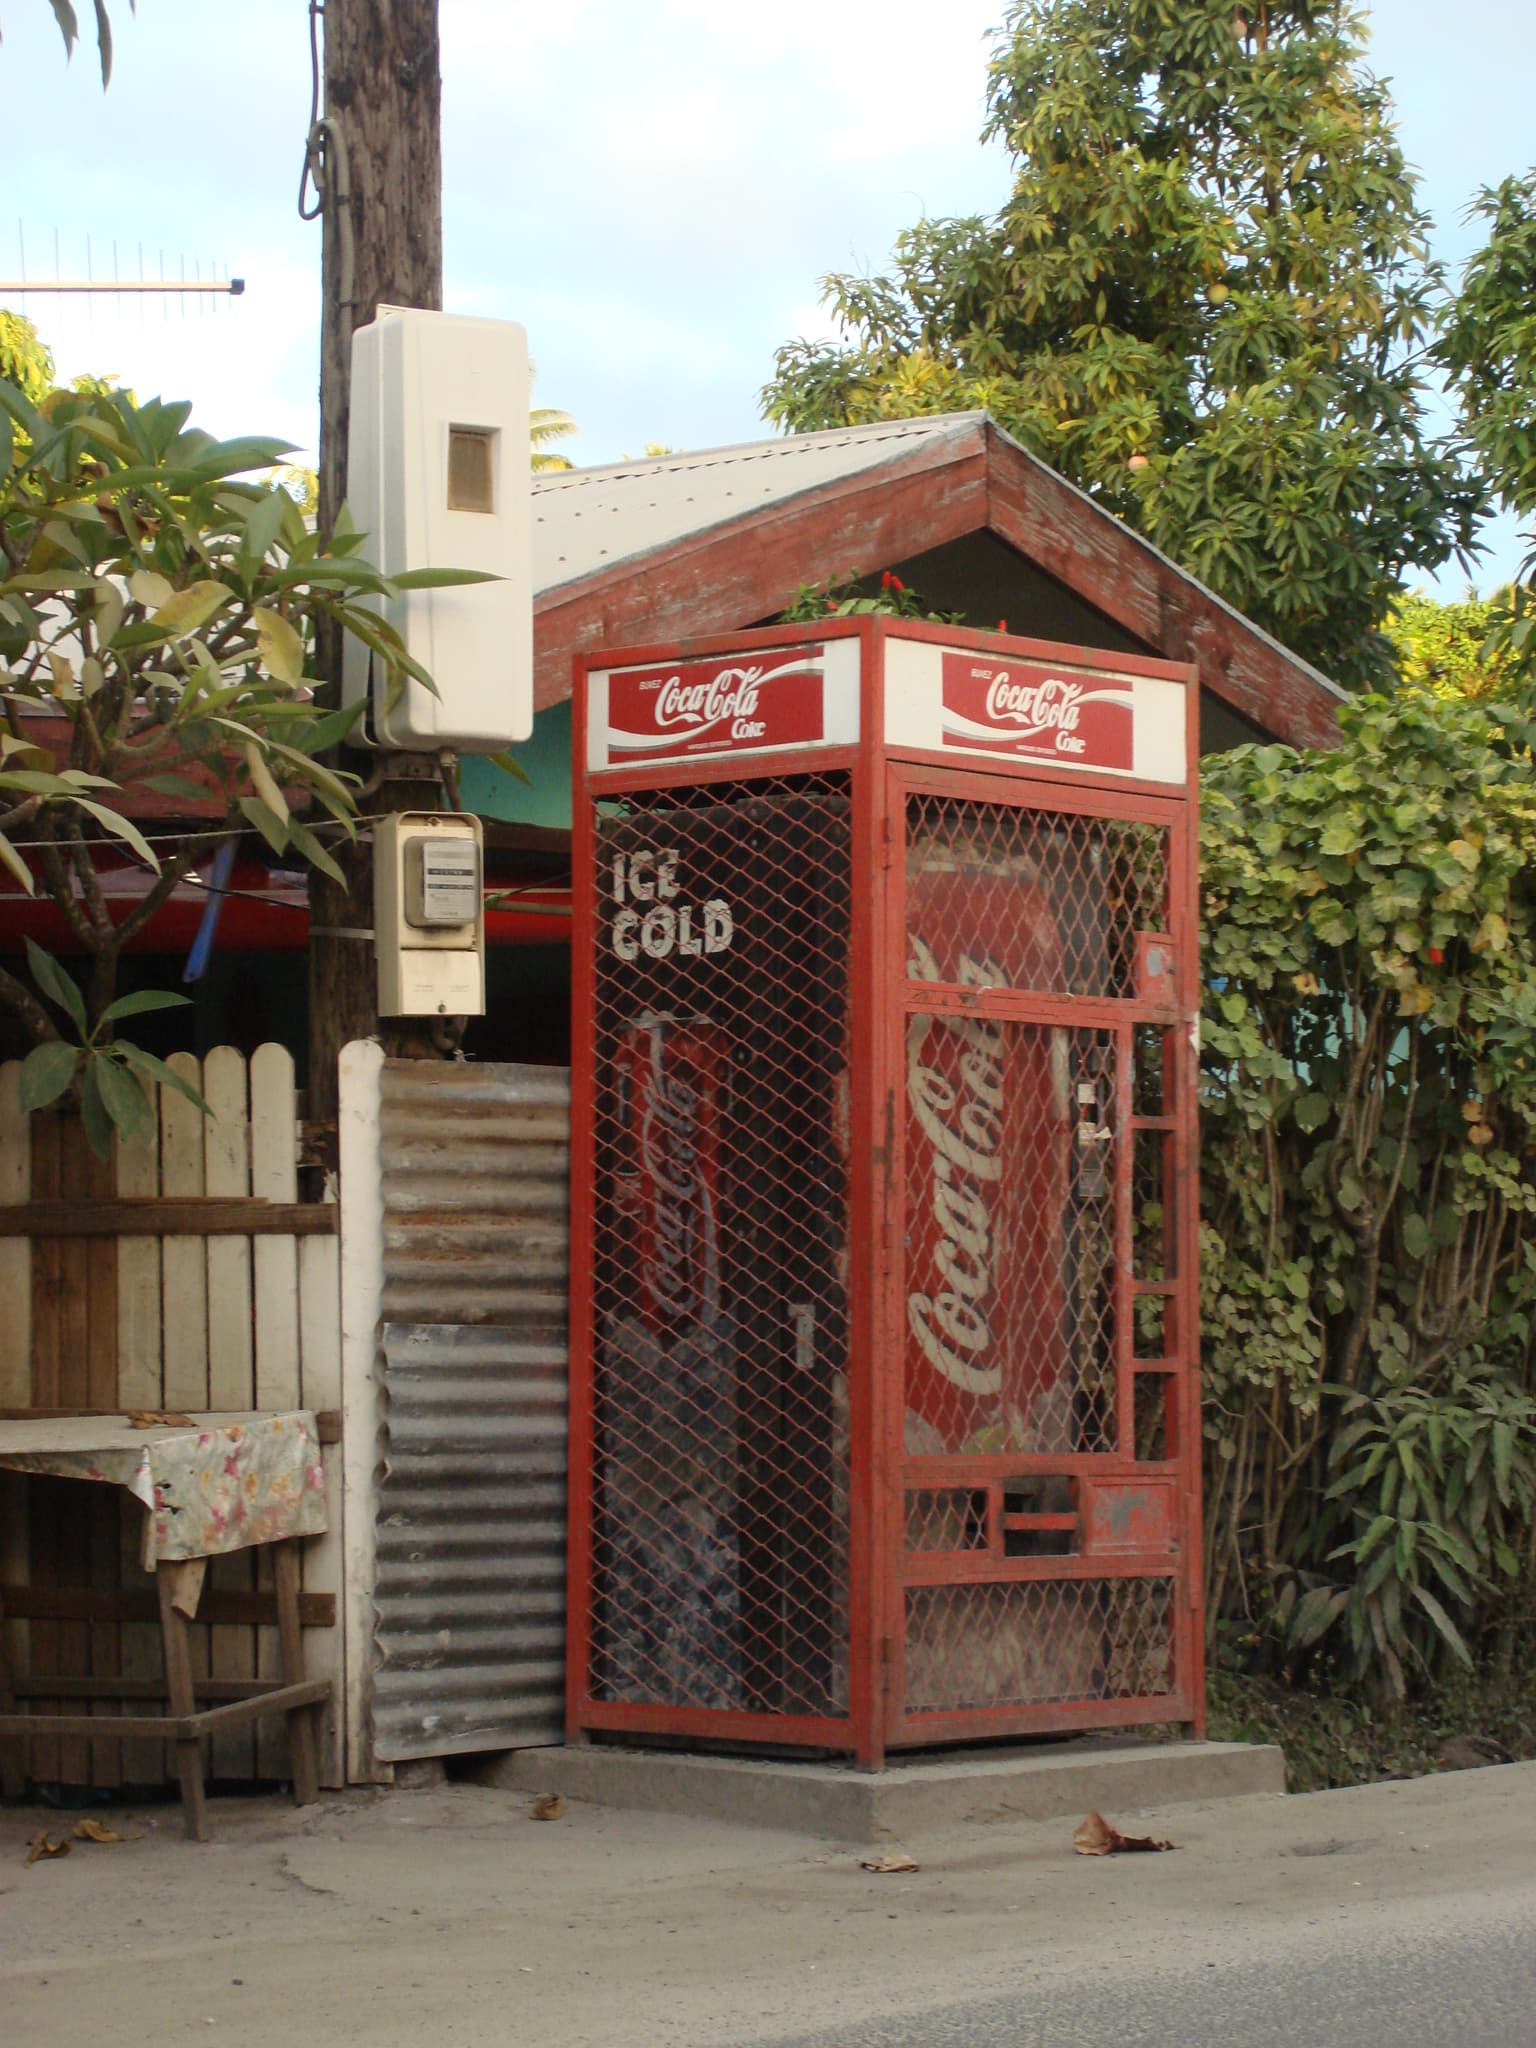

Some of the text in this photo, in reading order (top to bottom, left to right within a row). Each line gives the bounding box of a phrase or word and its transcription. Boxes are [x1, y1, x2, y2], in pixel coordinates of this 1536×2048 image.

[655, 666, 763, 726] Coca-Cola
[986, 672, 1084, 730] Coca-Cola
[731, 718, 766, 739] Coke
[1055, 730, 1086, 754] Coke
[612, 848, 680, 902] ICE
[612, 899, 734, 961] COLD
